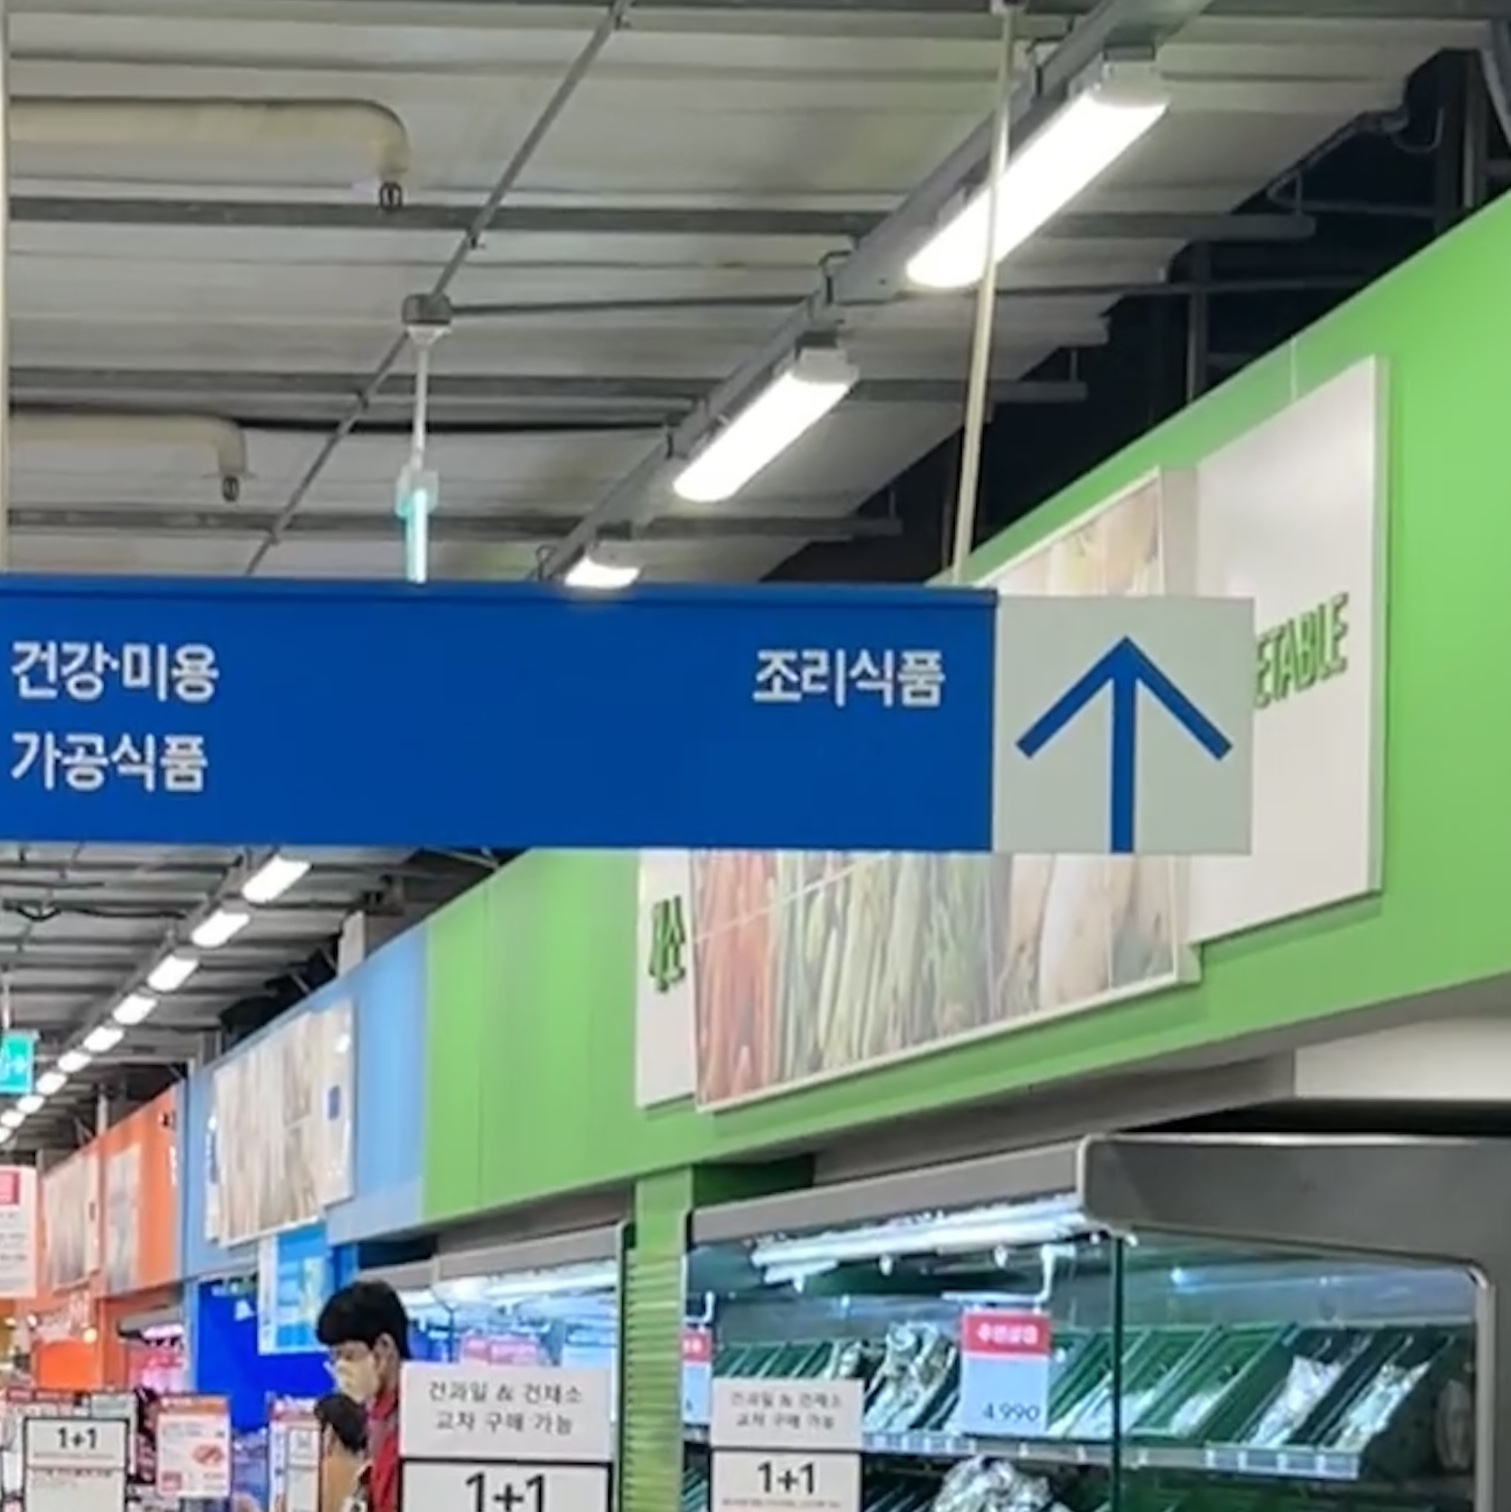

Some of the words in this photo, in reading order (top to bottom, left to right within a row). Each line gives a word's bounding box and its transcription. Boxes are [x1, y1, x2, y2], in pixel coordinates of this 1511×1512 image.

[10, 641, 219, 703] 건강·미용
[752, 648, 945, 708] 조리식품
[1252, 591, 1349, 709] ETABLE
[10, 733, 208, 792] 가공식품
[57, 1427, 97, 1448] 1+1
[757, 1460, 814, 1494] 1+1
